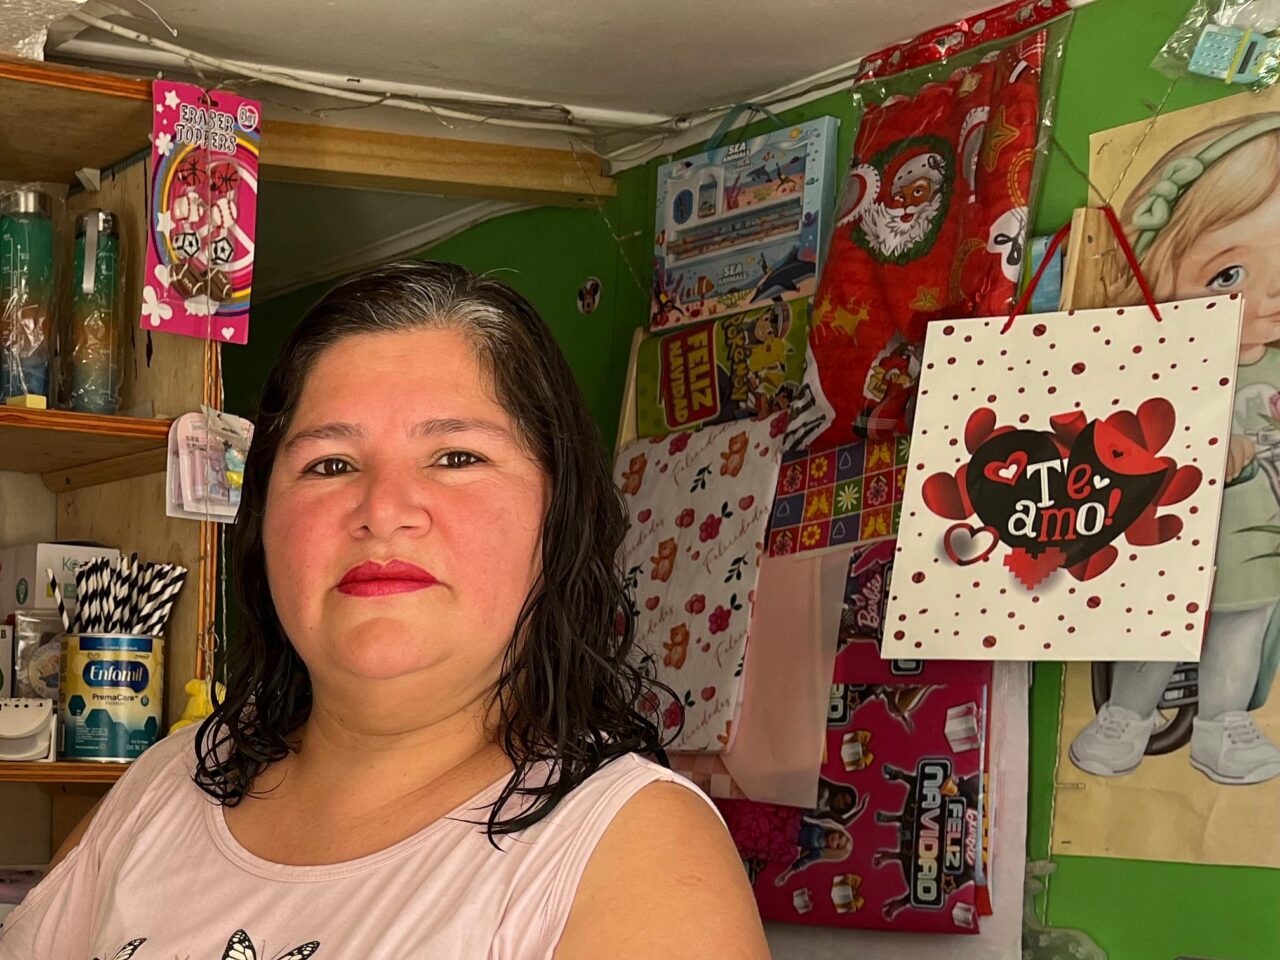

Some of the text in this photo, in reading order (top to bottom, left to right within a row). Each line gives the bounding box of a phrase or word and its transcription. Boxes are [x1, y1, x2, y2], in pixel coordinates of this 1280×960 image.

[174, 122, 238, 156] TOPPERS
[180, 103, 235, 134] ERASER
[728, 141, 747, 155] SEA
[723, 263, 743, 277] SEA
[669, 340, 689, 424] NAVIDAD
[687, 329, 714, 411] FELIZ
[1026, 458, 1092, 508] Te
[1007, 488, 1122, 542] amo!
[857, 574, 883, 630] Barbie
[89, 664, 144, 682] Enfamil
[917, 765, 945, 901] NAVIDAD
[945, 803, 964, 868] FELIZ
